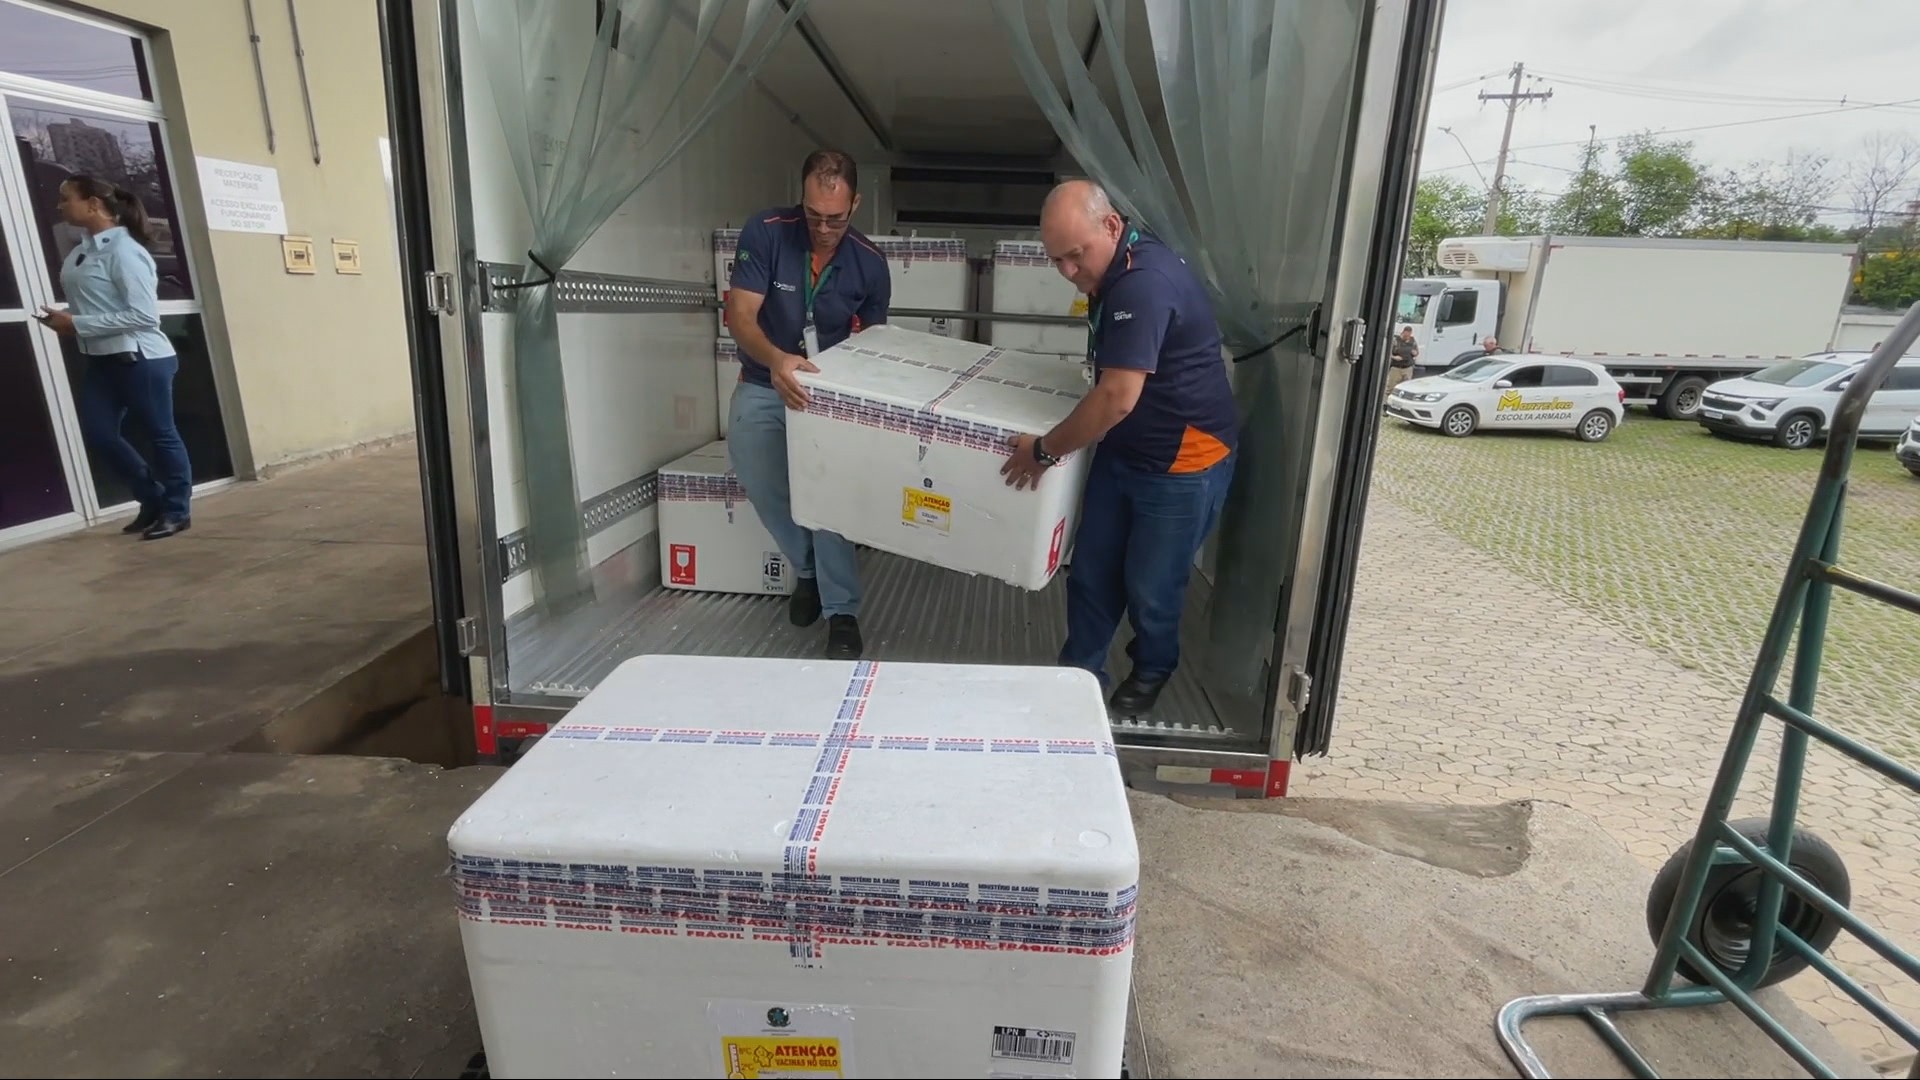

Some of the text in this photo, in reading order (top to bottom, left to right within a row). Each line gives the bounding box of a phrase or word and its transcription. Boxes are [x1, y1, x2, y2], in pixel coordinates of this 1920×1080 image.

[210, 199, 278, 212] ACESSO EXCLUSIVO
[243, 220, 265, 229] SETOR
[1494, 412, 1572, 421] ESCOLTA ARMADA
[924, 496, 950, 508] ATENÇÃO
[909, 879, 940, 887] MINISTÉRIO
[1048, 888, 1080, 896] MINISTÉRIO
[1001, 1028, 1019, 1036] LPN
[775, 1044, 837, 1059] ATENÇÃO
[775, 1059, 805, 1067] VACINAS
[807, 1060, 817, 1068] NO
[818, 1060, 838, 1068] GELO
